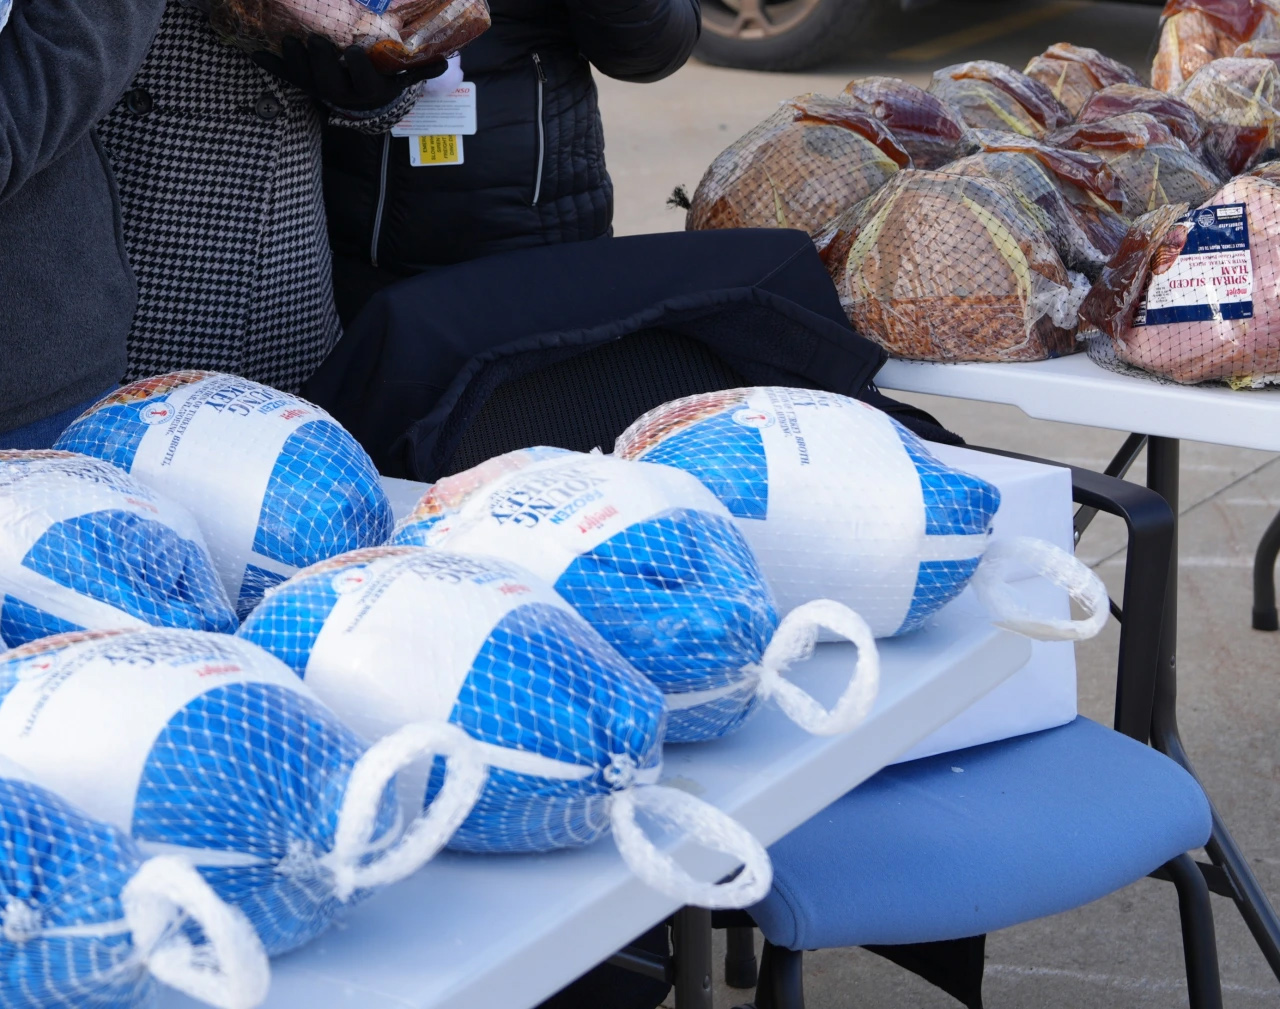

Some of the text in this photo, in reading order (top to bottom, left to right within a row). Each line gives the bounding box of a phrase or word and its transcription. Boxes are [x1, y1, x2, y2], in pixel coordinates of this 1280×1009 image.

[1169, 276, 1247, 289] SPIRAL SLICED
[1221, 265, 1249, 274] HAM
[1226, 288, 1247, 298] meijer
[179, 407, 200, 438] TURKEY
[513, 476, 609, 528] YOUNG
[550, 489, 604, 524] FROZEN
[577, 504, 619, 534] meijer
